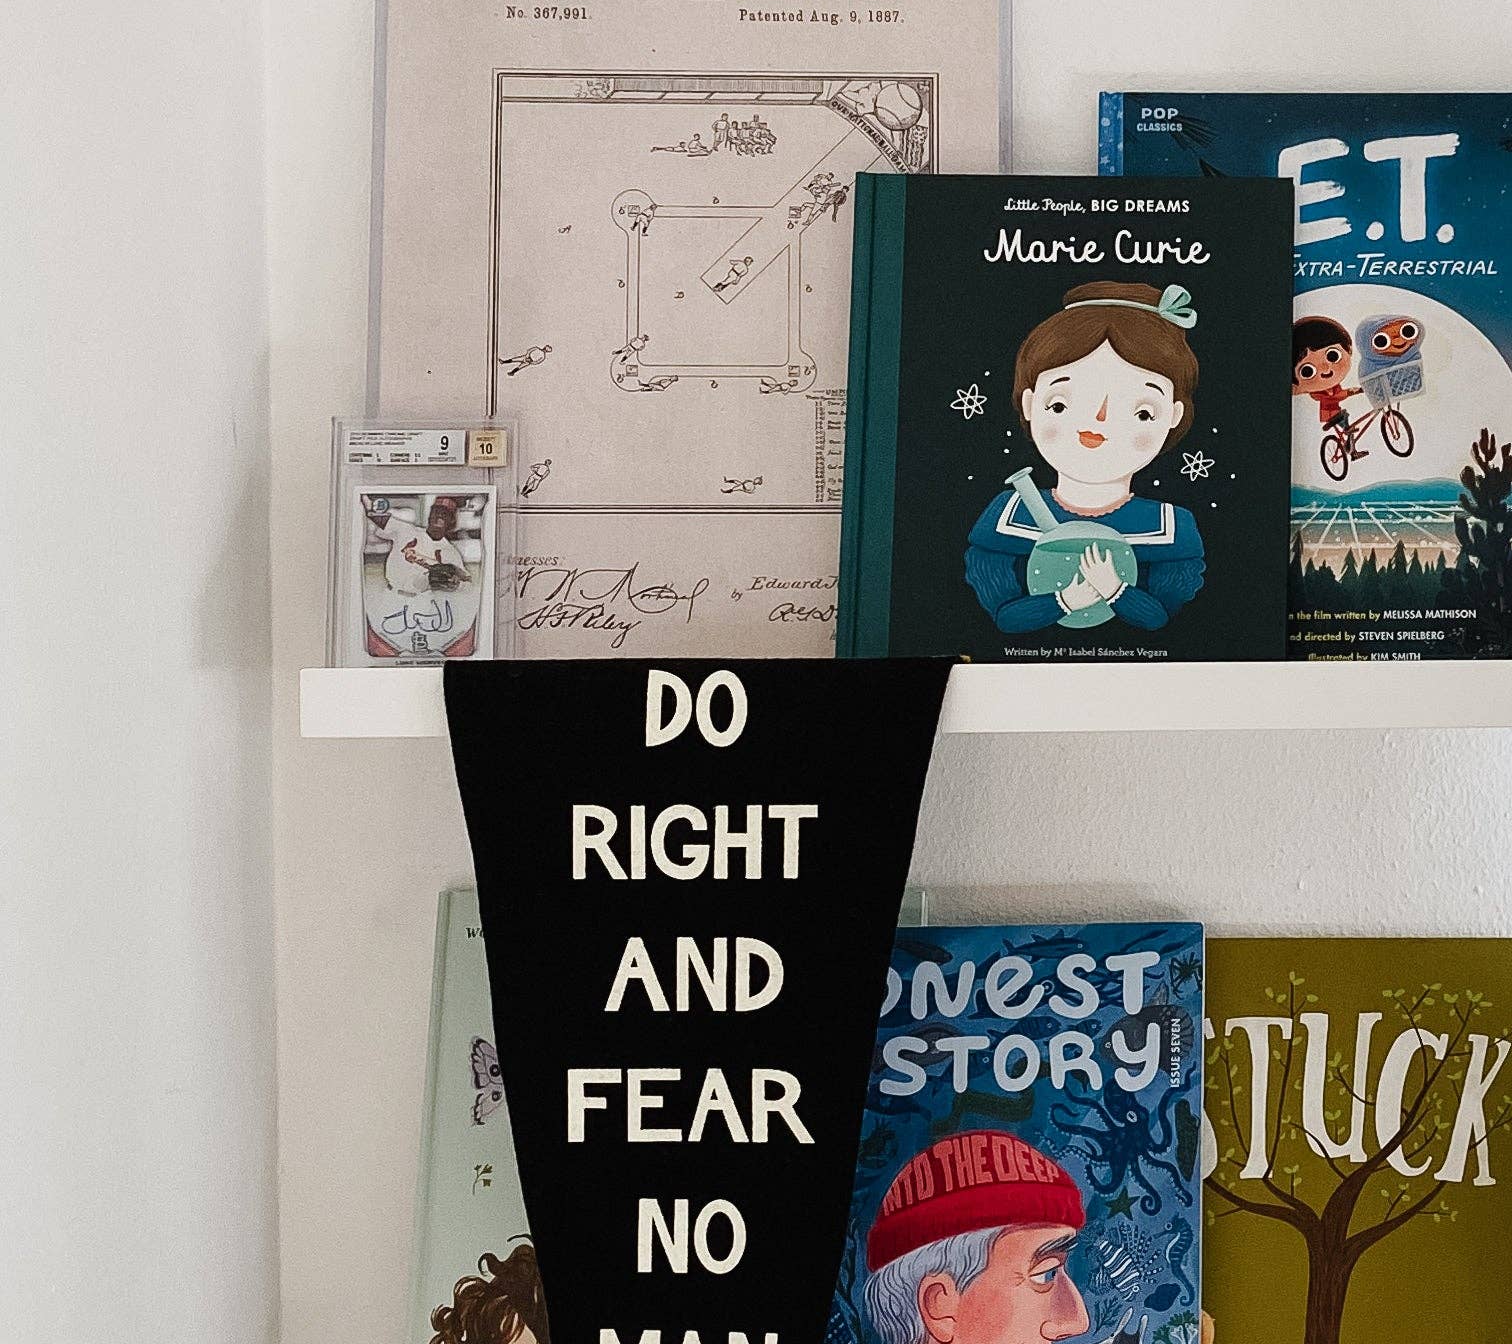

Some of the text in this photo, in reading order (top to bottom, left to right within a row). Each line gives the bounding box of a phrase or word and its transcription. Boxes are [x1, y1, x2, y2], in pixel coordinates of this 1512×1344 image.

[739, 9, 804, 23] Patented
[810, 11, 843, 25] Aug.
[868, 12, 905, 24] 1887.
[1141, 107, 1179, 120] POP
[1136, 122, 1183, 132] CLASSICS
[1278, 132, 1460, 246] E.T.
[1004, 198, 1190, 216] Little People, BIG DREAMS
[984, 229, 1211, 264] Marie Curie
[1294, 253, 1498, 277] XTRA-TERRESTRIAL
[441, 436, 449, 451] 9
[479, 443, 493, 455] 10
[1297, 610, 1311, 620] the
[1314, 610, 1331, 620] film
[1334, 610, 1366, 620] written
[1369, 609, 1380, 622] by
[1383, 609, 1422, 619] MELISSA
[1425, 609, 1477, 619] MATHISON
[1290, 630, 1445, 643] nd directed by STEVEN SPIELBERG
[1004, 647, 1038, 656] Written
[1041, 647, 1051, 658] by
[1069, 647, 1095, 656] Isabel
[1098, 647, 1134, 656] Sánchez
[1137, 648, 1168, 658] Vegara
[1371, 652, 1389, 661] KIM
[1393, 652, 1421, 661] SMITH
[646, 669, 748, 747] DO
[572, 804, 818, 880] RIGHT
[604, 937, 784, 1012] AND
[880, 1022, 1160, 1095] STORY
[1170, 1018, 1181, 1088] ISSUE SEVEN
[567, 1068, 815, 1144] FEAR
[882, 1134, 1059, 1216] INTO THE DEEP
[637, 1198, 747, 1274] NO
